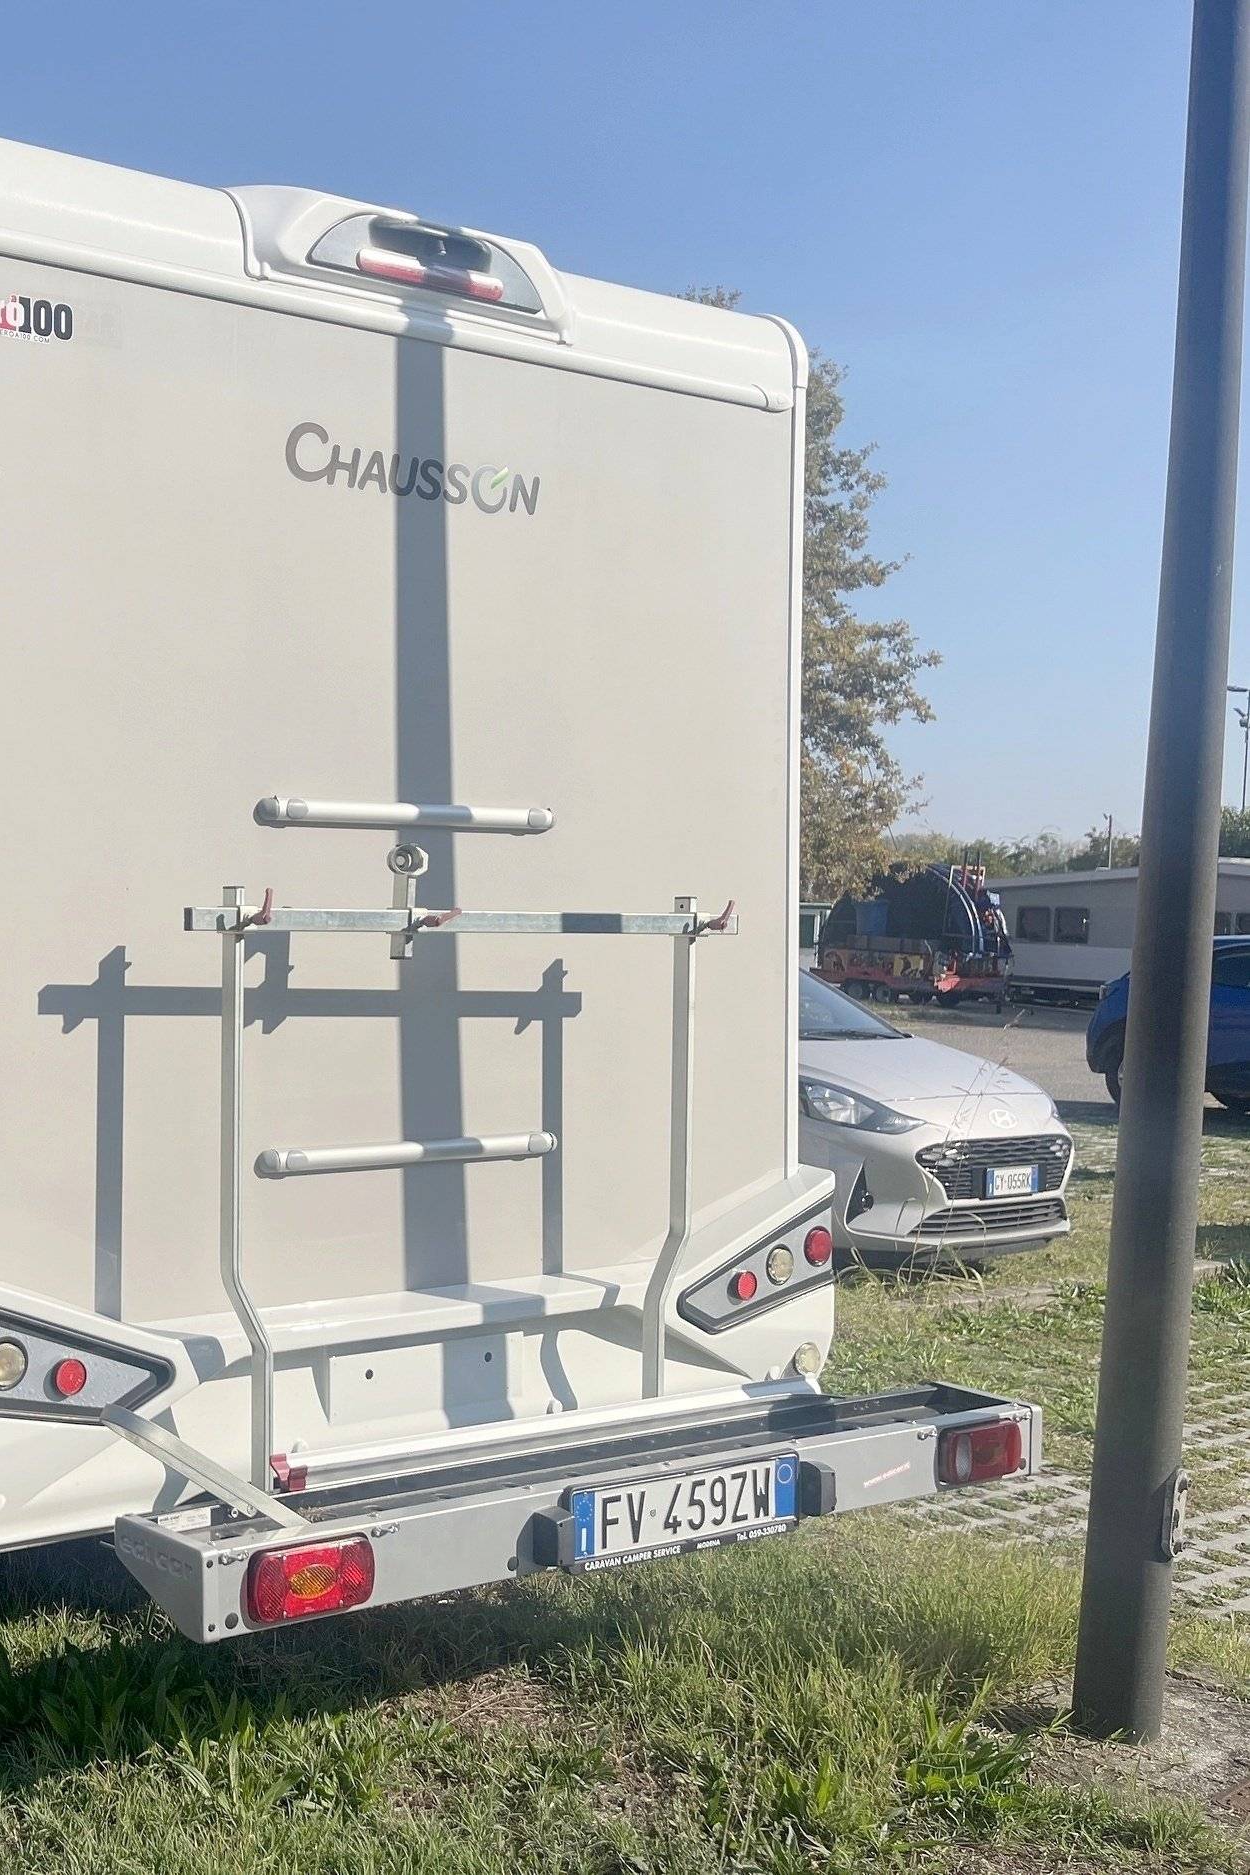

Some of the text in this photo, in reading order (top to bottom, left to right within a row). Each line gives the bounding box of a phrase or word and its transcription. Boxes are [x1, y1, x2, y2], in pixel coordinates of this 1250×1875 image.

[285, 421, 541, 515] CHAUSSON
[601, 1467, 771, 1549] FV 459ZW
[584, 1545, 681, 1571] CARAVAN CAMPER SERVICE
[696, 1539, 721, 1549] MODENA
